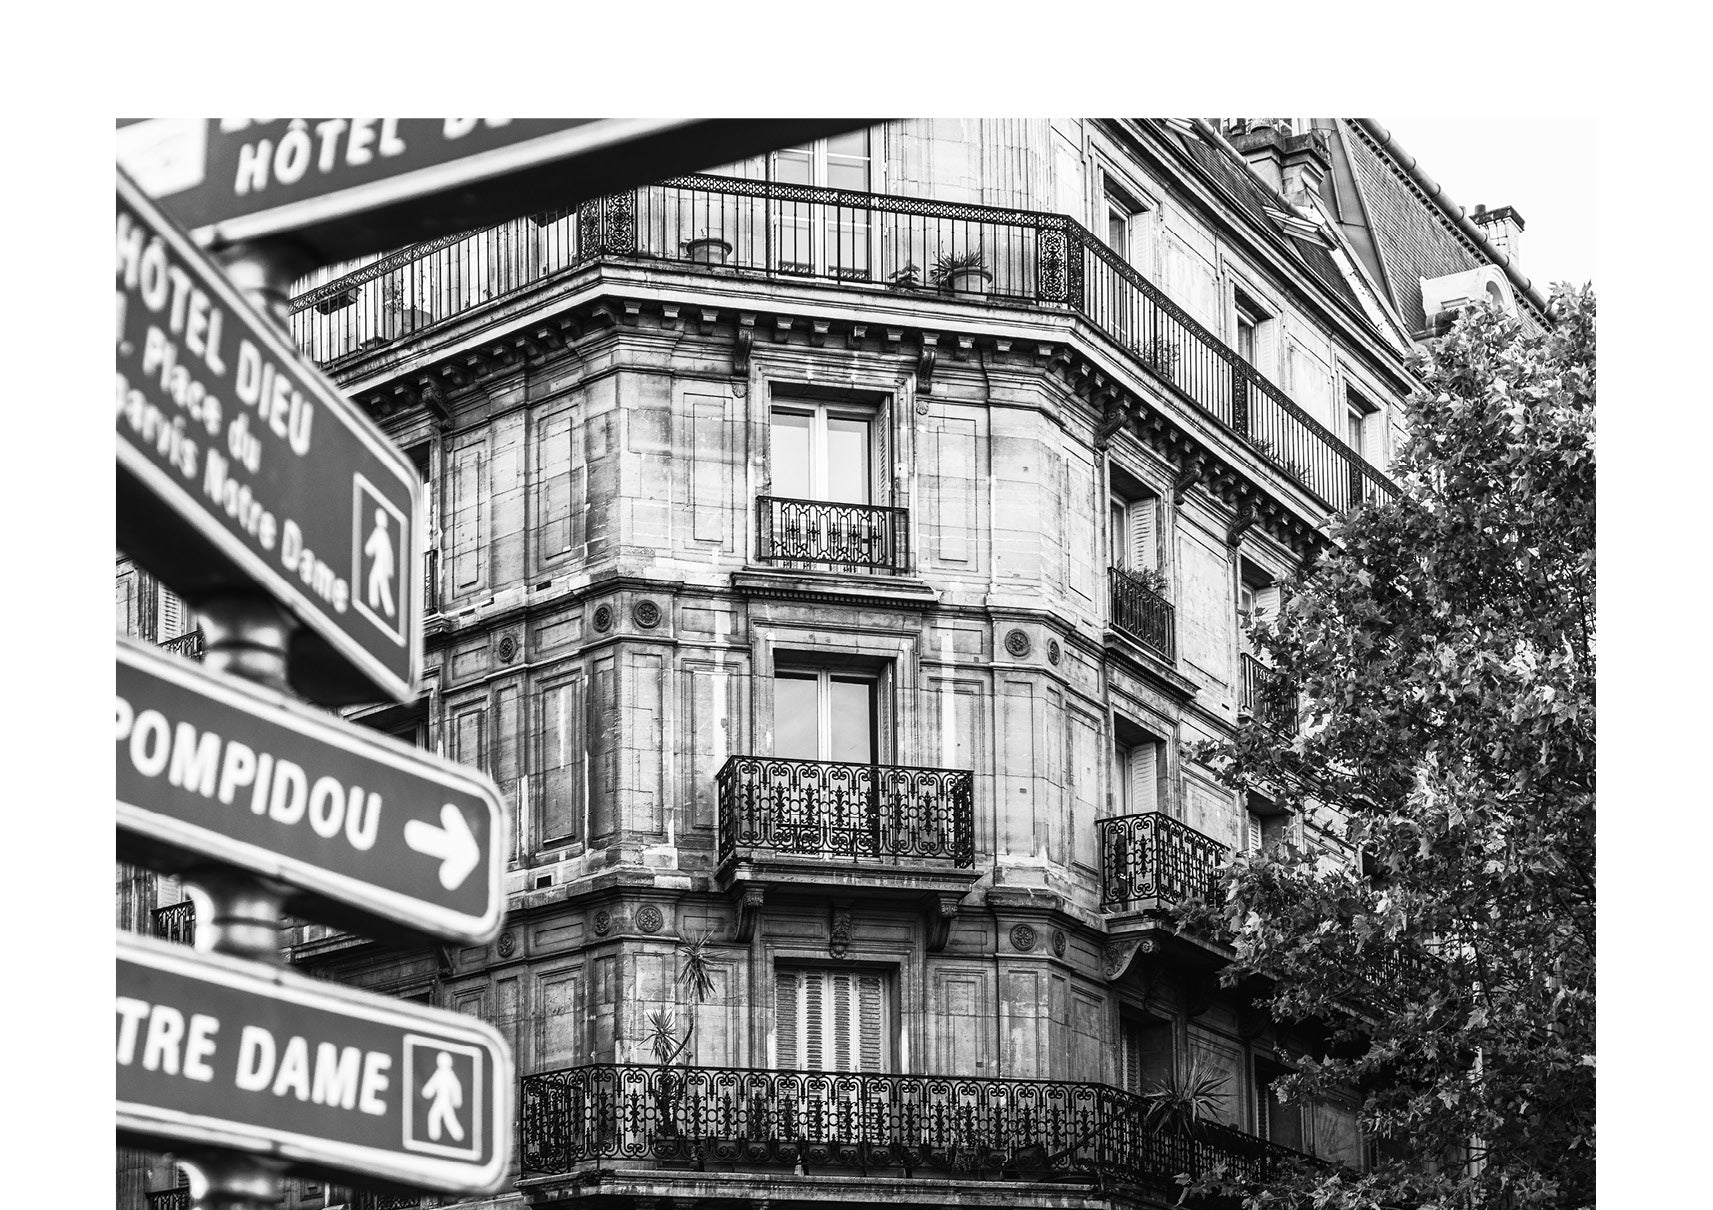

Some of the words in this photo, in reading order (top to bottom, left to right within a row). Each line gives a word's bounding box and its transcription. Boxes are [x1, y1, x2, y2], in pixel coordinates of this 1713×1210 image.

[234, 118, 406, 196] HÔTEL
[116, 212, 226, 376] HÔTEL
[235, 339, 314, 457] DIEU
[142, 325, 223, 436] Place
[227, 411, 262, 475] du
[203, 447, 277, 551] Notre
[281, 518, 349, 614] Dame
[234, 1023, 394, 1117] DAME
